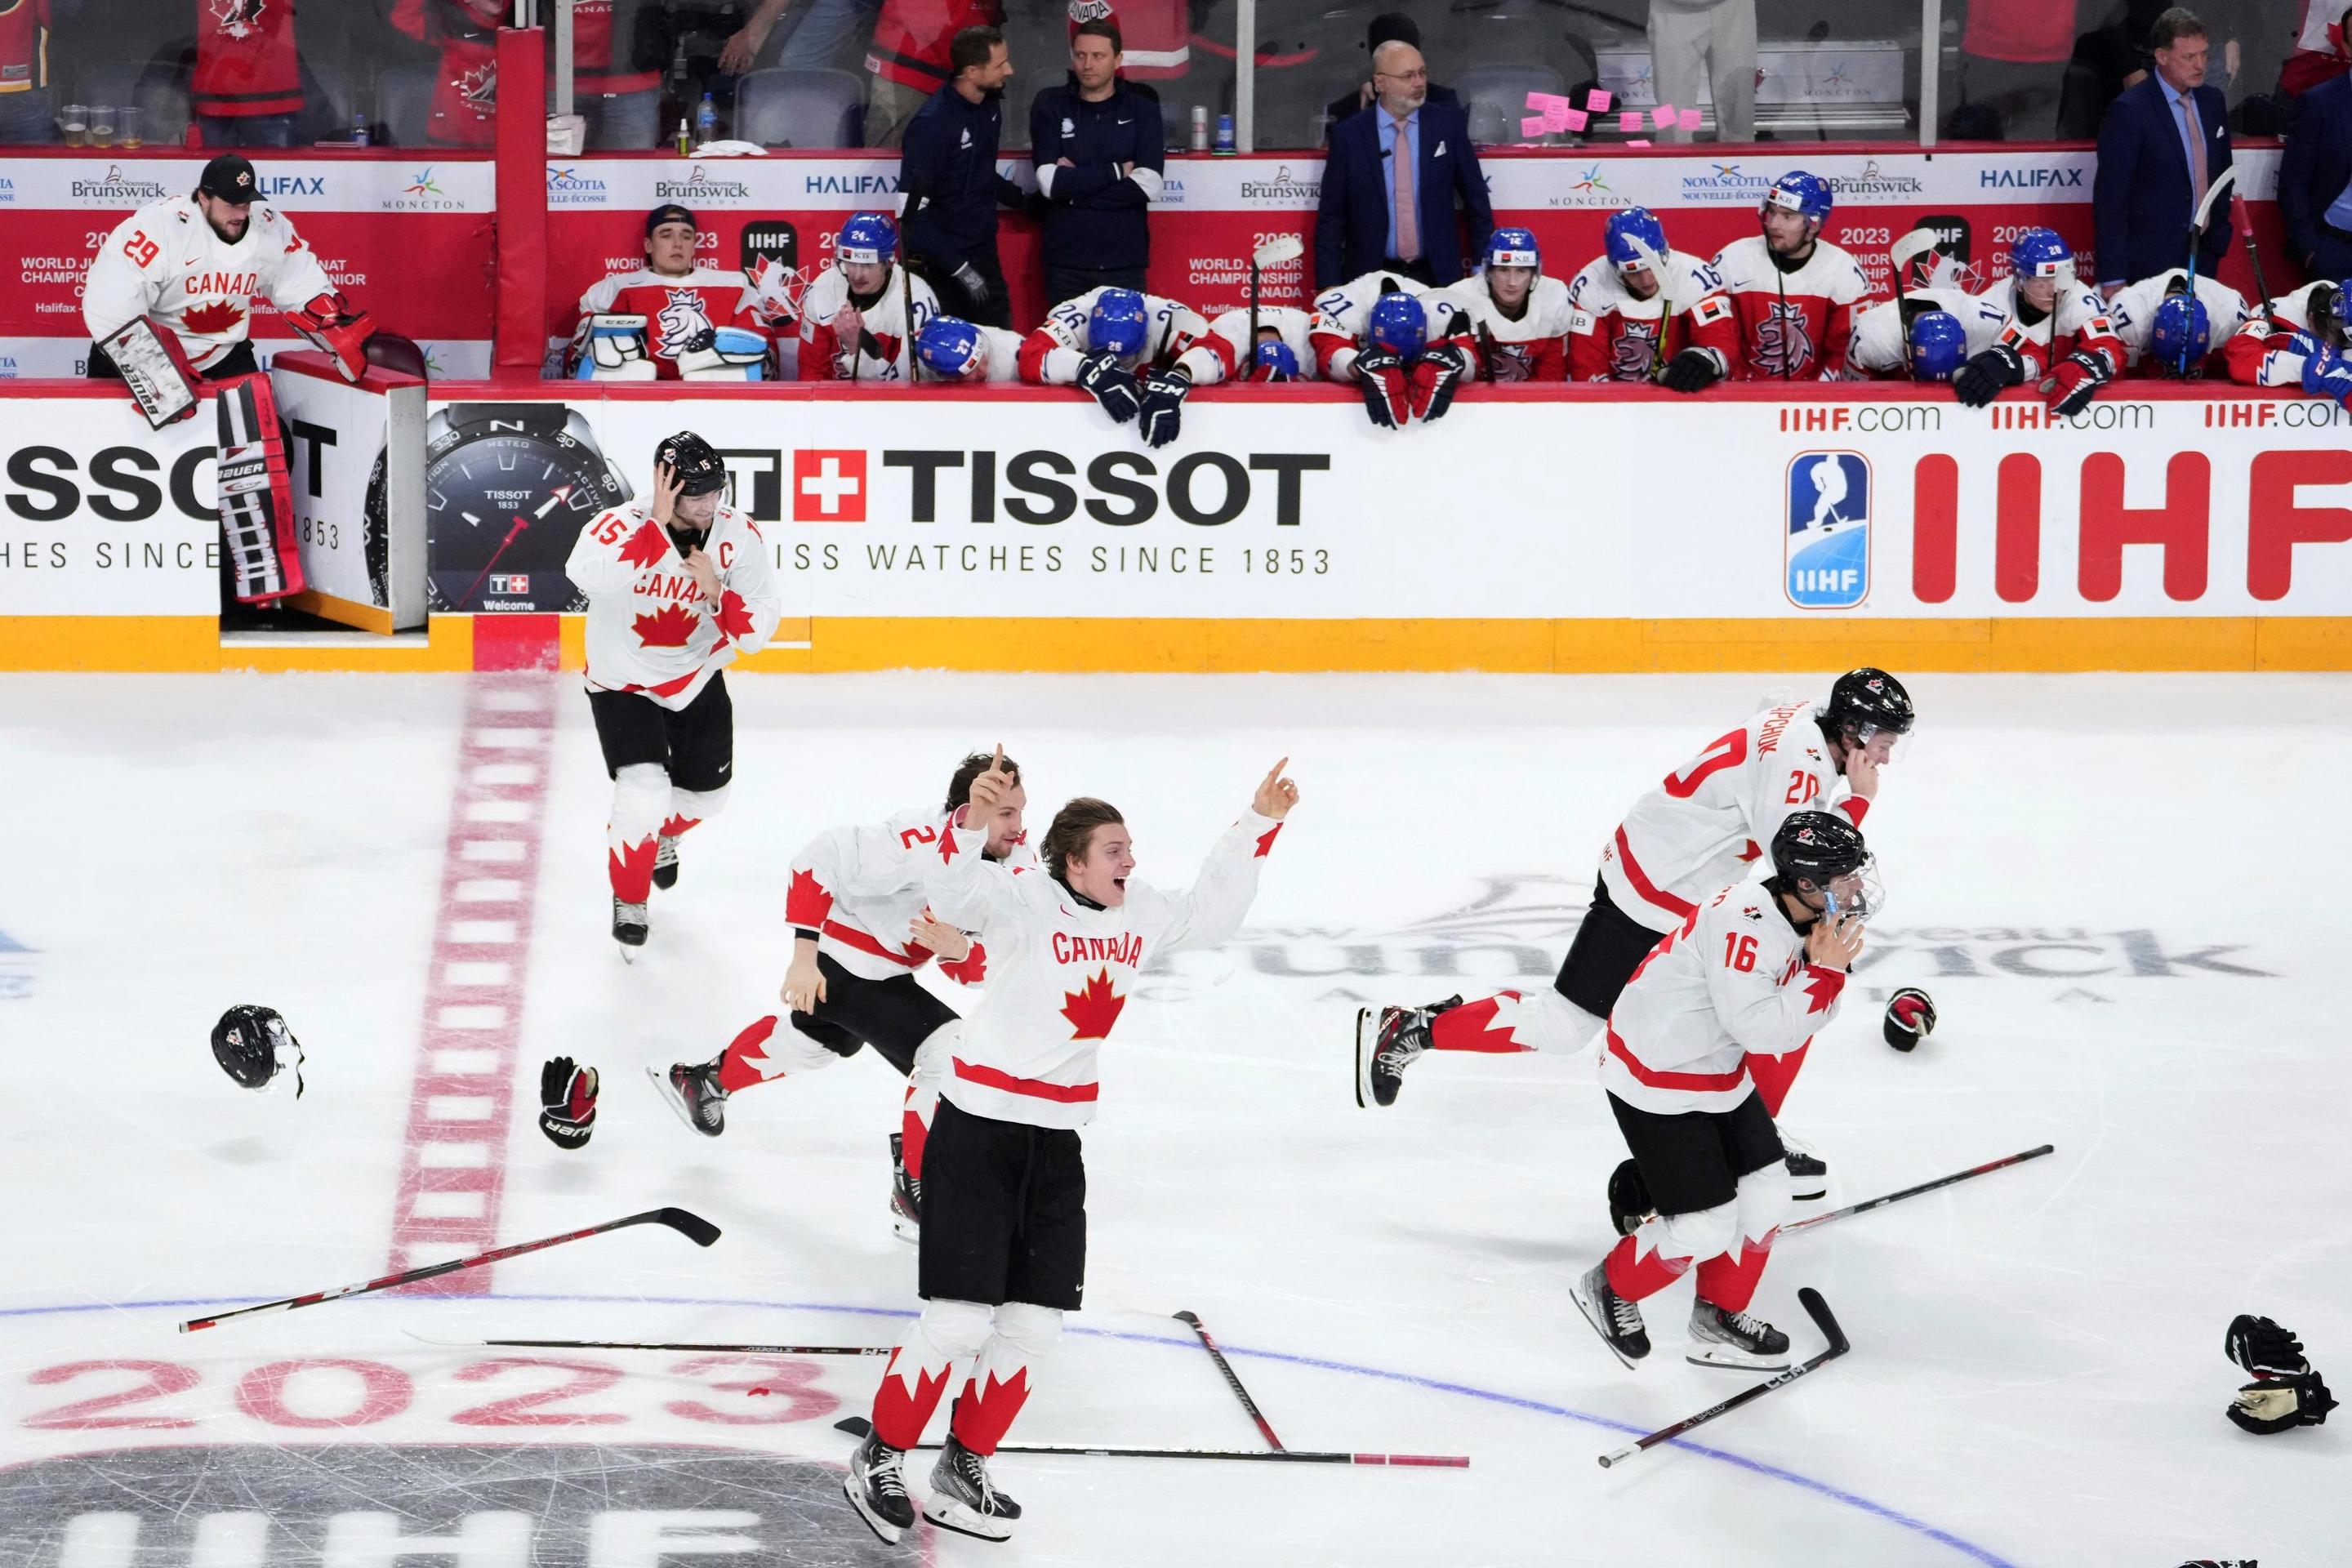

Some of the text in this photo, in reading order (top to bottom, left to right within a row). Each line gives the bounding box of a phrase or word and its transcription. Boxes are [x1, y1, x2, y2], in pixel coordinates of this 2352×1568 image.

[1682, 177, 1713, 188] NOVA
[1830, 177, 1922, 194] Brunswick
[1980, 169, 2082, 187] HALIFAX
[72, 182, 166, 197] Brunswick
[656, 182, 749, 198] Brunswick
[382, 200, 465, 210] MONCTON
[1548, 197, 1633, 206] MONCTON
[1778, 194, 1793, 204] KB
[748, 234, 790, 248] IIHF
[852, 230, 866, 240] 24
[1840, 228, 1890, 244] 2023
[123, 229, 160, 269] 29
[21, 258, 76, 270] WORLD
[1189, 259, 1244, 270] WORLD
[35, 303, 76, 313] Halifax
[1319, 292, 1354, 318] 21
[1054, 304, 1088, 330] 26
[1054, 326, 1071, 346] KB
[1108, 341, 1122, 352] 26
[120, 363, 159, 415] BAUER
[490, 420, 524, 432] N
[1780, 407, 1941, 432] IIHF.com
[432, 430, 461, 451] 330
[487, 440, 530, 449] METEO
[555, 433, 577, 448] 30
[699, 460, 710, 471] 15
[484, 490, 532, 500] TISSOT
[884, 450, 1330, 527] TISSOT
[497, 501, 519, 510] 1853
[590, 513, 628, 546] 15
[1912, 450, 2352, 603] IIHF
[96, 541, 219, 569] SINCE
[719, 541, 733, 569] C
[867, 545, 1062, 572] WATCHES
[1091, 546, 1214, 573] SINCE
[1242, 550, 1330, 575] 1853
[1797, 569, 1858, 592] IIHF
[483, 599, 535, 612] Welcome
[1784, 769, 1820, 804] 20
[1793, 858, 1819, 866] BAUER
[1052, 931, 1143, 969] CANADA
[1725, 931, 1758, 973] 16
[1765, 1364, 1808, 1389] CCM
[20, 1356, 841, 1430] 2023
[952, 1475, 972, 1499] BAUER
